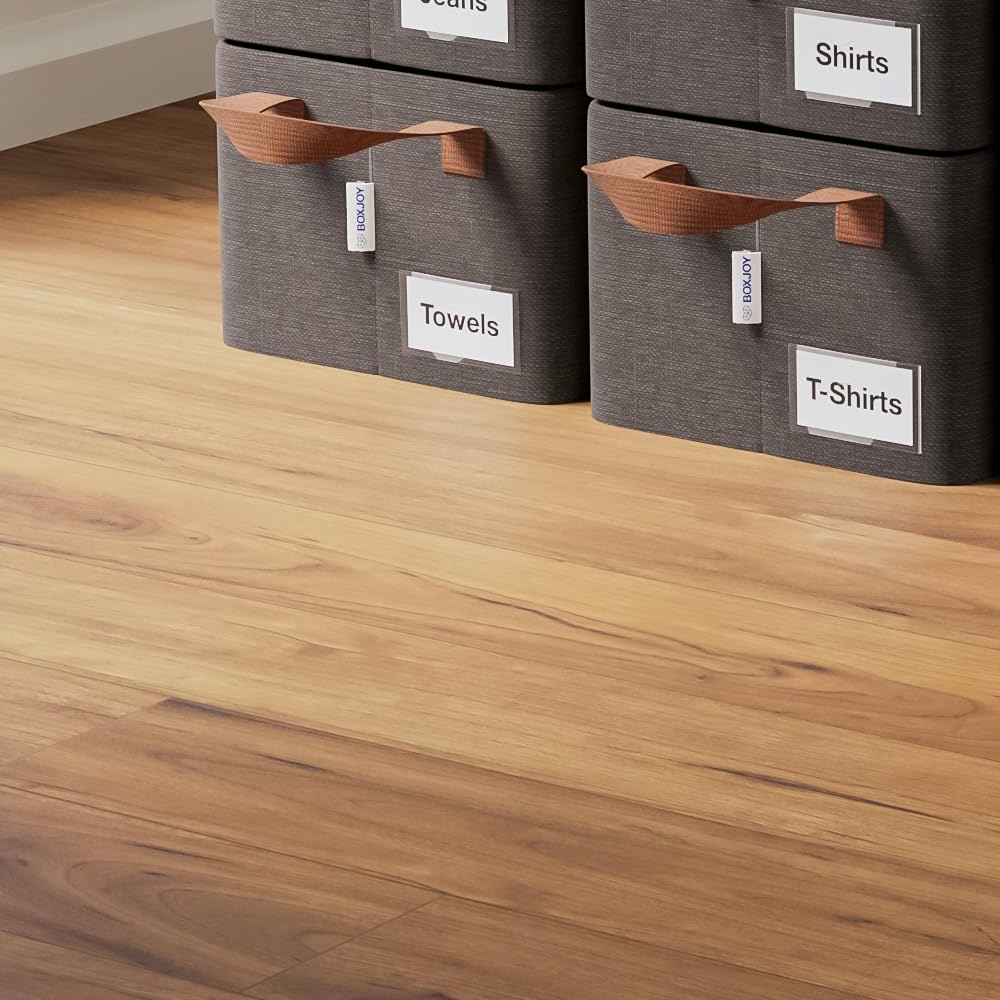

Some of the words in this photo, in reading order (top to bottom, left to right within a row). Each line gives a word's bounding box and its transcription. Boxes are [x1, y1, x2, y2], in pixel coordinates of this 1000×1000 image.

[815, 42, 889, 75] Shirts
[355, 187, 365, 232] BOXJOY
[742, 257, 752, 303] BOXJOY
[420, 302, 499, 337] Towels
[806, 376, 903, 416] T-Shirts
